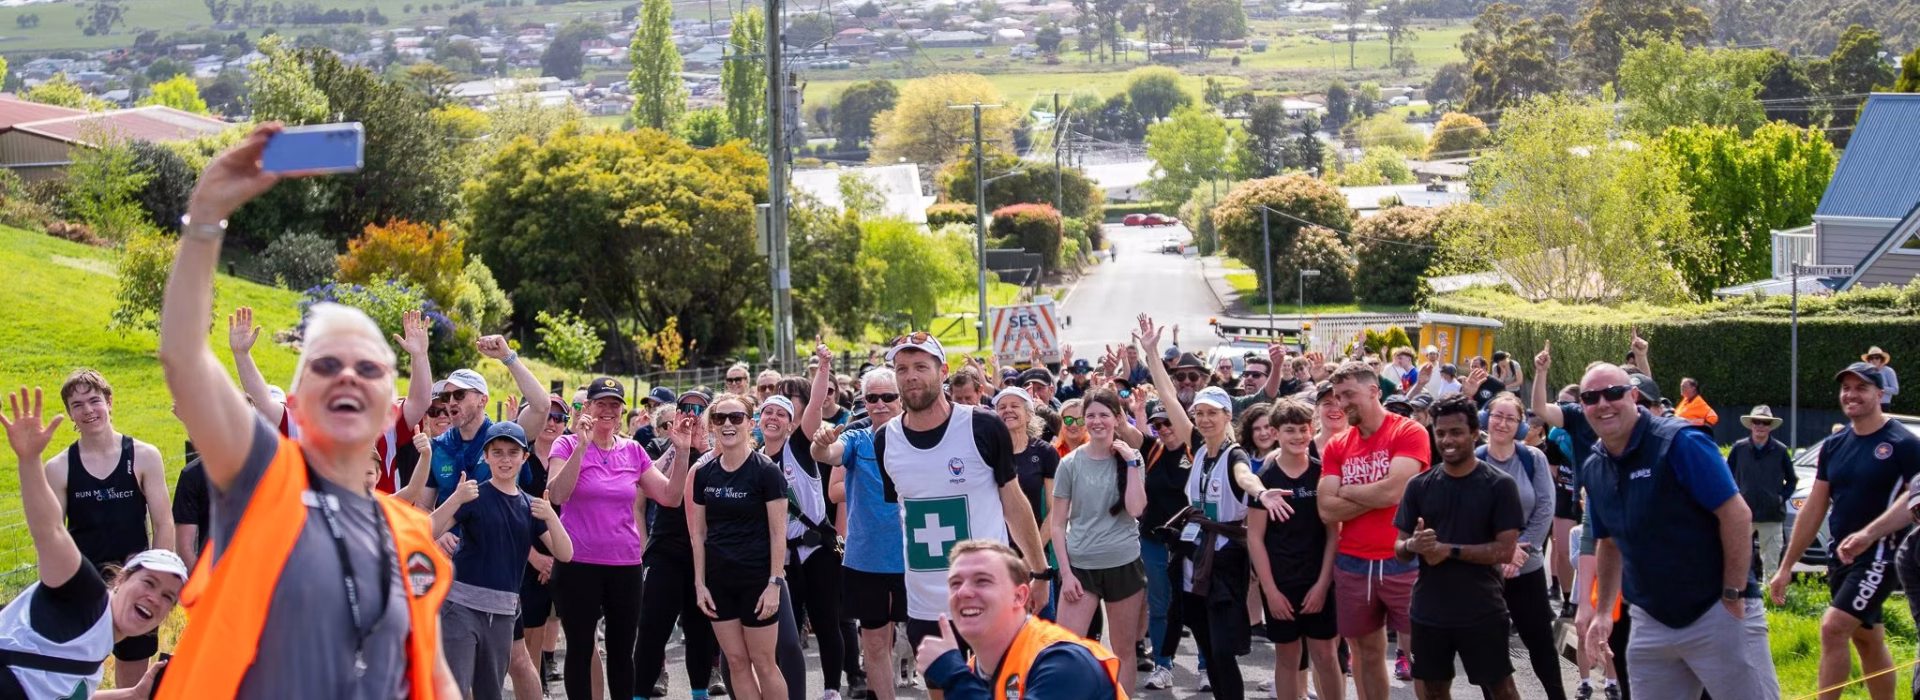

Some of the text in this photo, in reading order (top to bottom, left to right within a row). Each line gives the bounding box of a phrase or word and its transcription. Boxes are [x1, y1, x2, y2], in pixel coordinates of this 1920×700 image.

[1799, 266, 1853, 276] BEAUTY VIEW RD
[1009, 313, 1038, 328] SES
[1003, 330, 1046, 342] RESCUE
[75, 490, 91, 499] RUN
[1852, 560, 1888, 611] adida
